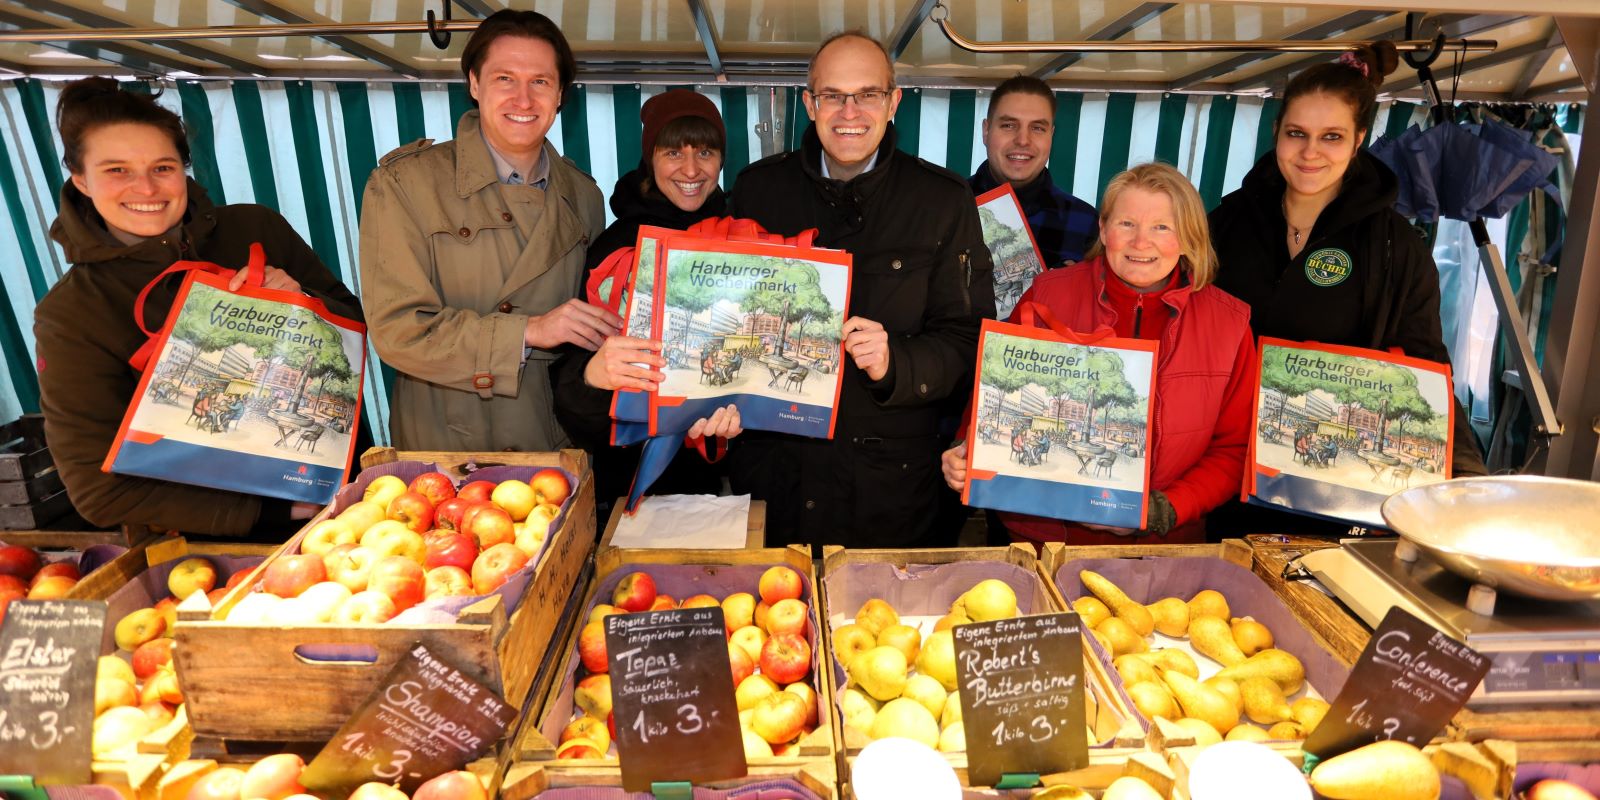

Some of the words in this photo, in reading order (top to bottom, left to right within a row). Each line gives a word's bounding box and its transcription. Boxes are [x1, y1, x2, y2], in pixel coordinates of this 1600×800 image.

[690, 260, 779, 280] Harburger
[1308, 259, 1346, 275] BÜCHEL
[689, 274, 797, 294] Wochenmarkt
[211, 300, 308, 330] Harburger
[209, 311, 324, 349] Wochenmarkt
[1003, 344, 1083, 367] Harburger
[1285, 353, 1374, 378] Harburger
[1003, 357, 1100, 381] Wochenmarkt
[1285, 363, 1393, 394] Wochenmarkt
[778, 412, 805, 422] Hamburg
[283, 474, 313, 485] Hamburg
[1090, 499, 1117, 509] Hamburg
[609, 617, 646, 636] Eigene
[650, 612, 681, 625] Ernte
[693, 612, 713, 621] aus
[955, 626, 991, 642] Eigene
[995, 619, 1026, 632] Ernte
[1035, 617, 1056, 627] aus
[628, 630, 685, 649] integriertem
[973, 632, 1037, 650] integriertem
[0, 637, 76, 670] Elstar
[616, 647, 680, 677] Topaz
[959, 644, 1040, 677] Robert's
[1375, 630, 1469, 693] Conference
[411, 645, 450, 675] Eigene
[446, 669, 480, 698] Ernte
[966, 672, 1076, 708] Butterbirne
[385, 680, 483, 750] Shampion
